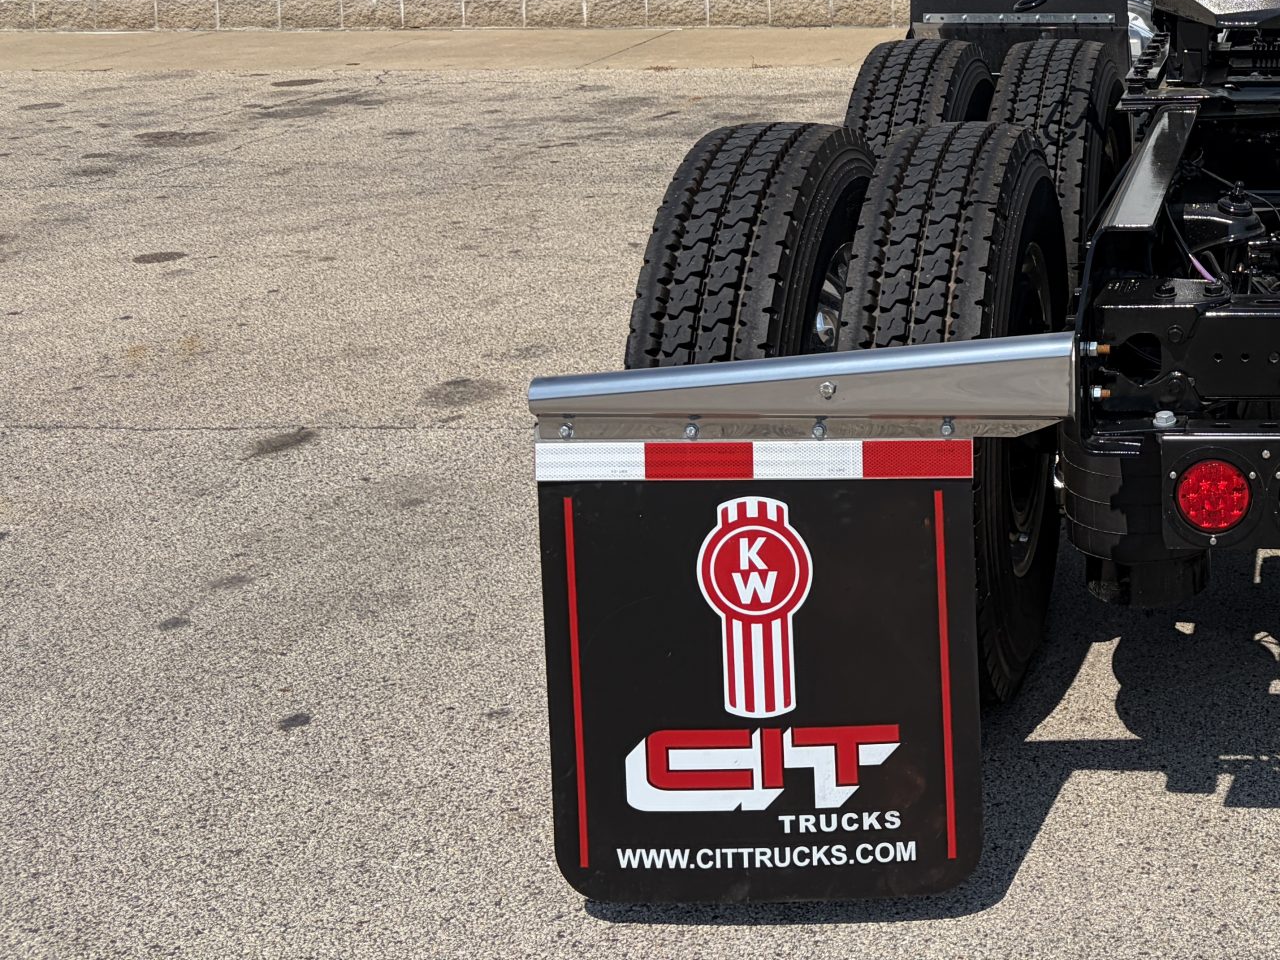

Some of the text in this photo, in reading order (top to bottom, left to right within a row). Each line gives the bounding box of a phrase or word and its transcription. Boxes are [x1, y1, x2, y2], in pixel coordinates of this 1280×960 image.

[738, 537, 767, 570] K
[731, 571, 778, 605] W
[625, 724, 901, 811] CIT
[778, 810, 902, 834] TRUCKS
[616, 840, 917, 869] WWW.CITTRUCKS.COM
